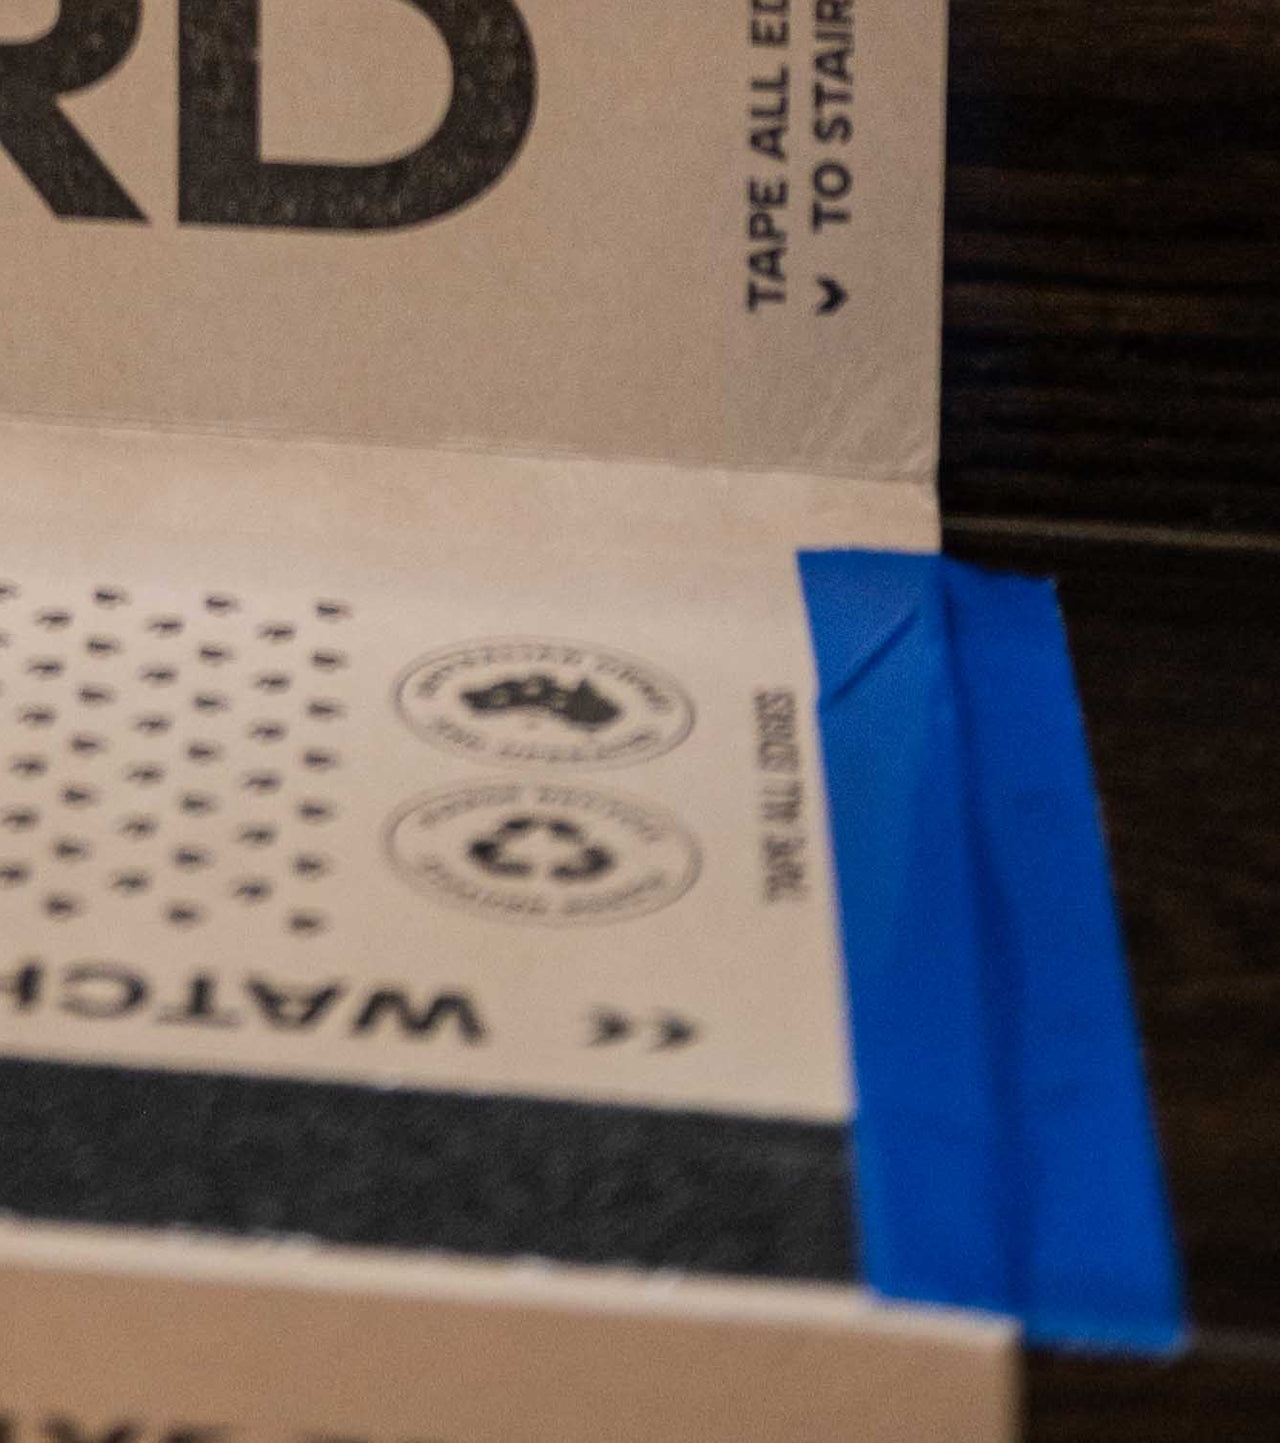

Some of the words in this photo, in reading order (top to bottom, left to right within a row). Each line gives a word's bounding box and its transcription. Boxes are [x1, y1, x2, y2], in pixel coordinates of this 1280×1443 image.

[749, 67, 789, 161] ALL
[811, 161, 852, 232] TO
[747, 181, 788, 311] TAPE
